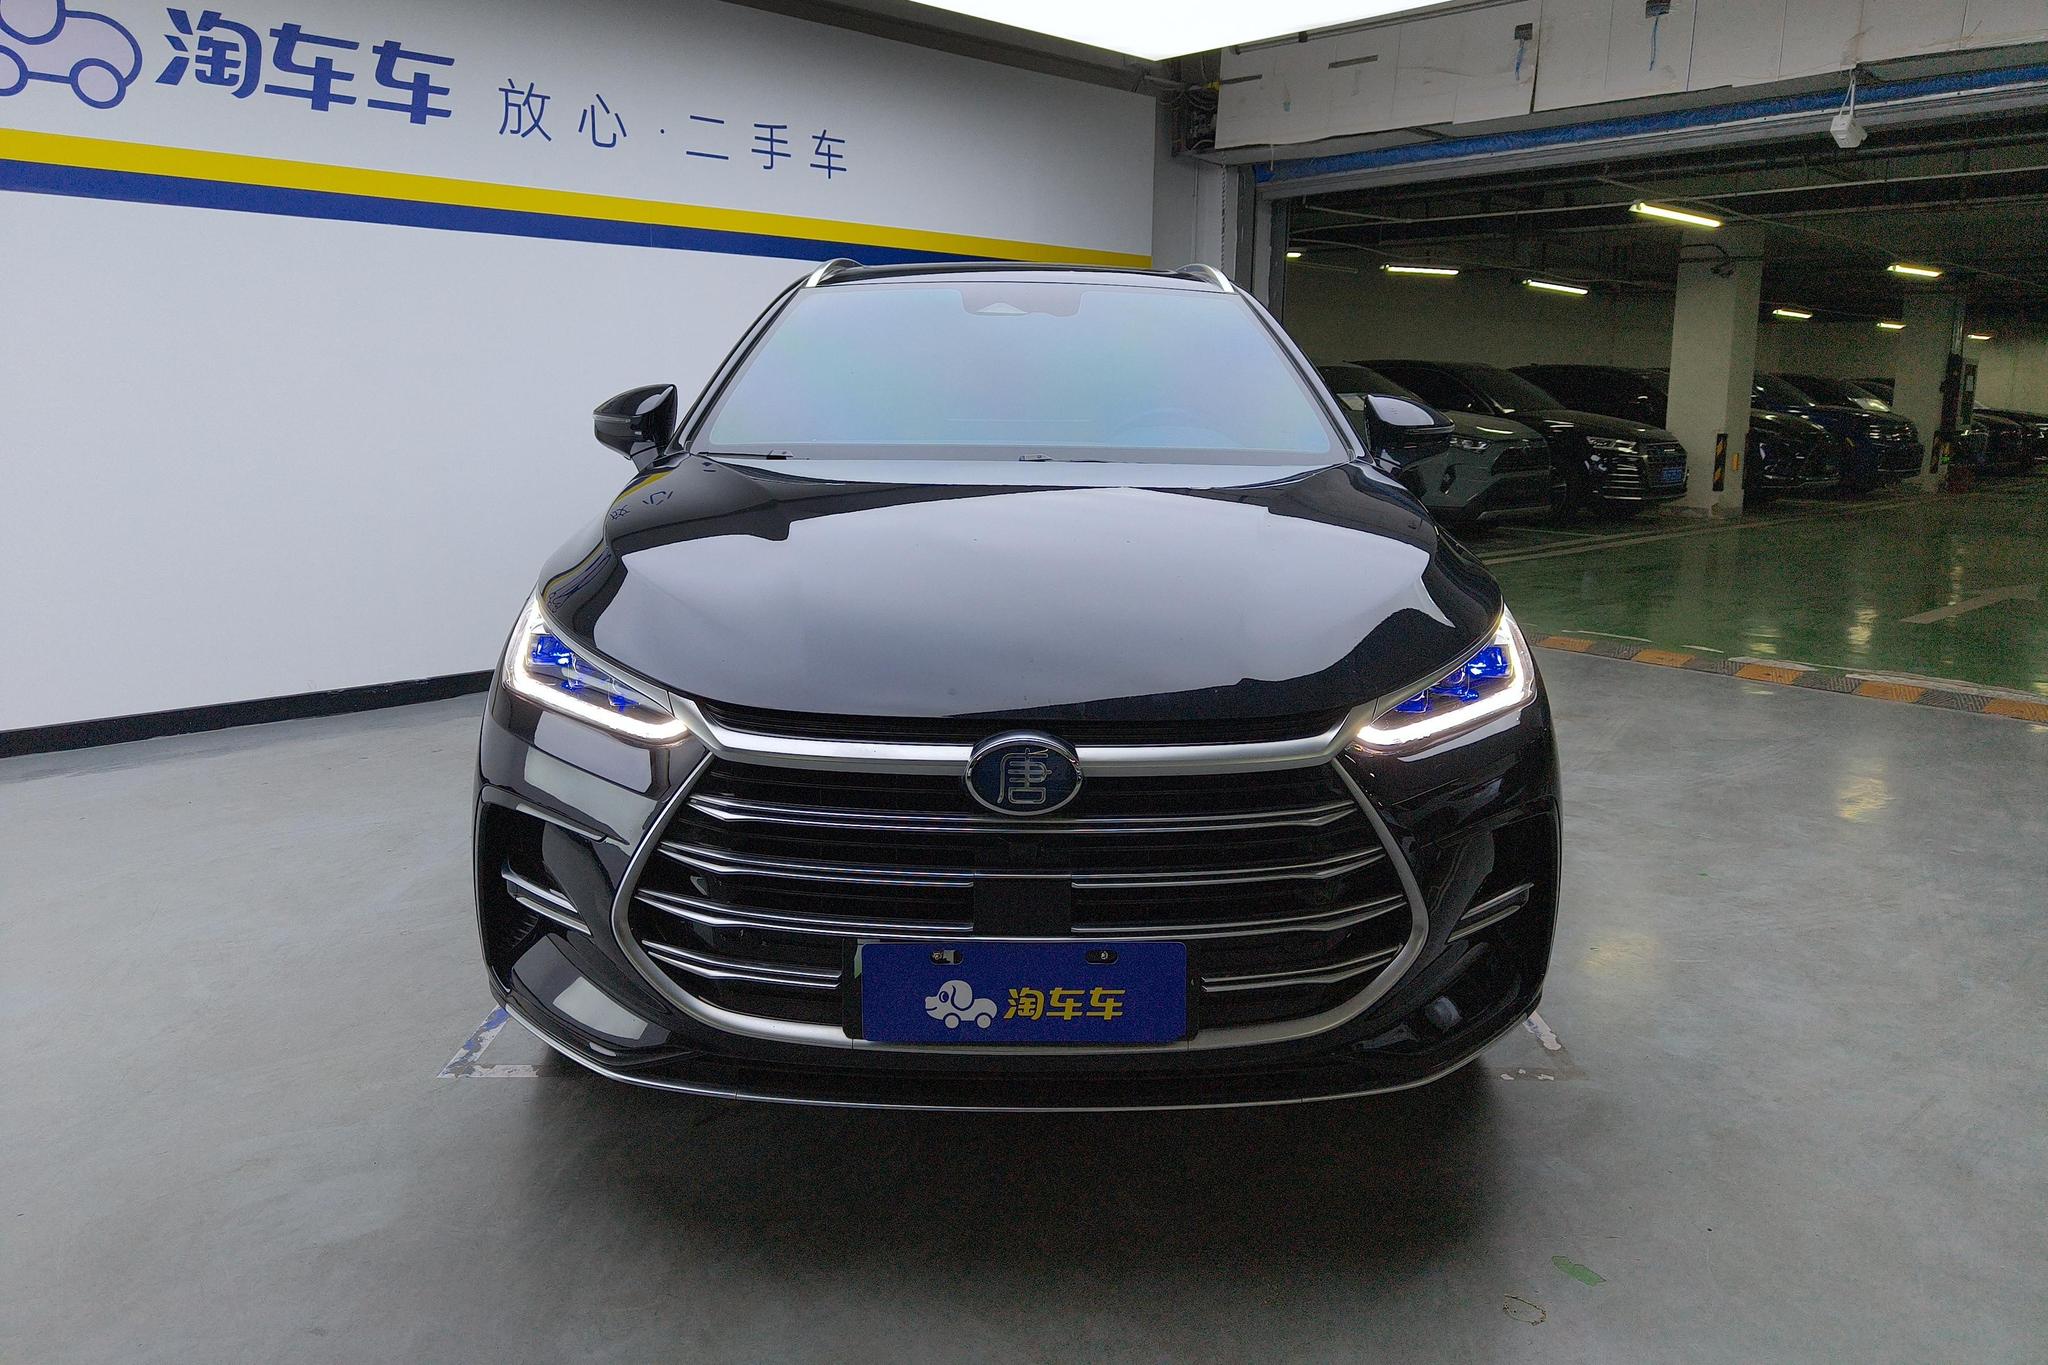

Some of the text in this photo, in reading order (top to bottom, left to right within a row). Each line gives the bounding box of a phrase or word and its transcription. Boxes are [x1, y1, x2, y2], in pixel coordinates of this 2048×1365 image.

[155, 7, 455, 125] 淘车车
[997, 747, 1053, 805] 唐
[1003, 986, 1126, 1021] 淘车车
